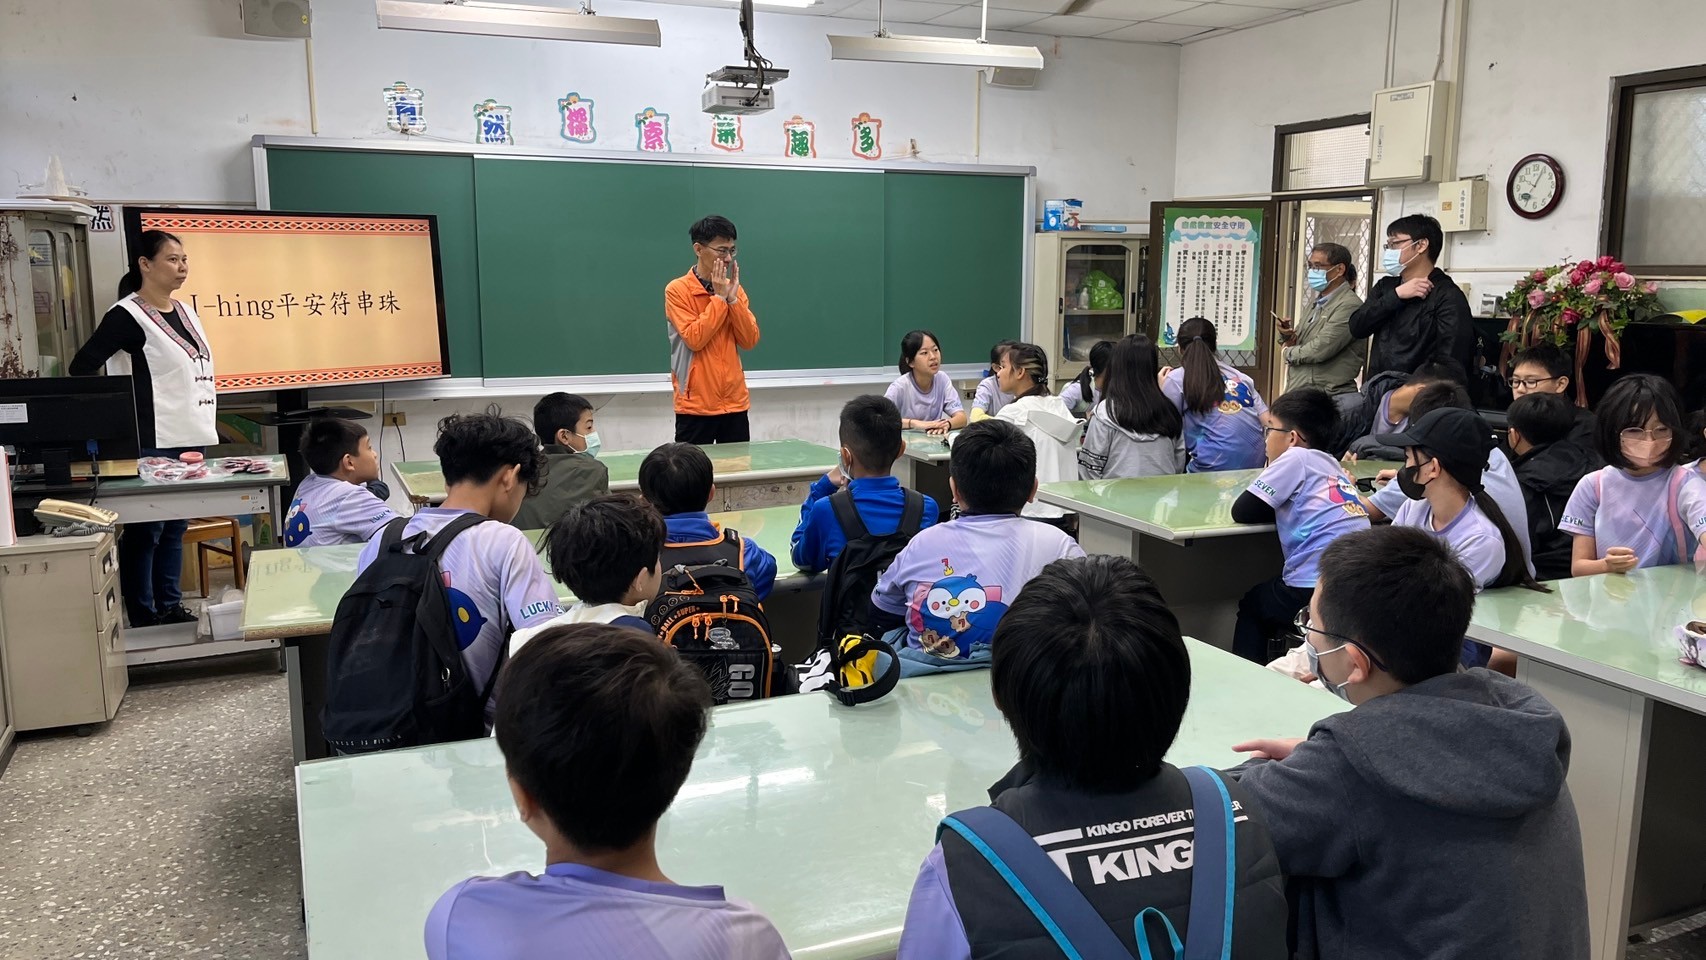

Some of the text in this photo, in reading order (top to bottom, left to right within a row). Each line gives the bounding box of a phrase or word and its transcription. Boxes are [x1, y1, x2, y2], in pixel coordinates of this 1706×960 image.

[483, 115, 506, 143] 然
[644, 121, 664, 149] 索
[791, 128, 809, 157] 趣
[860, 126, 874, 152] 多
[1255, 479, 1277, 497] SEVEN
[660, 605, 696, 632] BALL SUPER
[727, 664, 755, 700] GO
[1086, 820, 1132, 838] KINGO
[1132, 809, 1186, 831] FOREVER
[1087, 839, 1194, 885] KING
